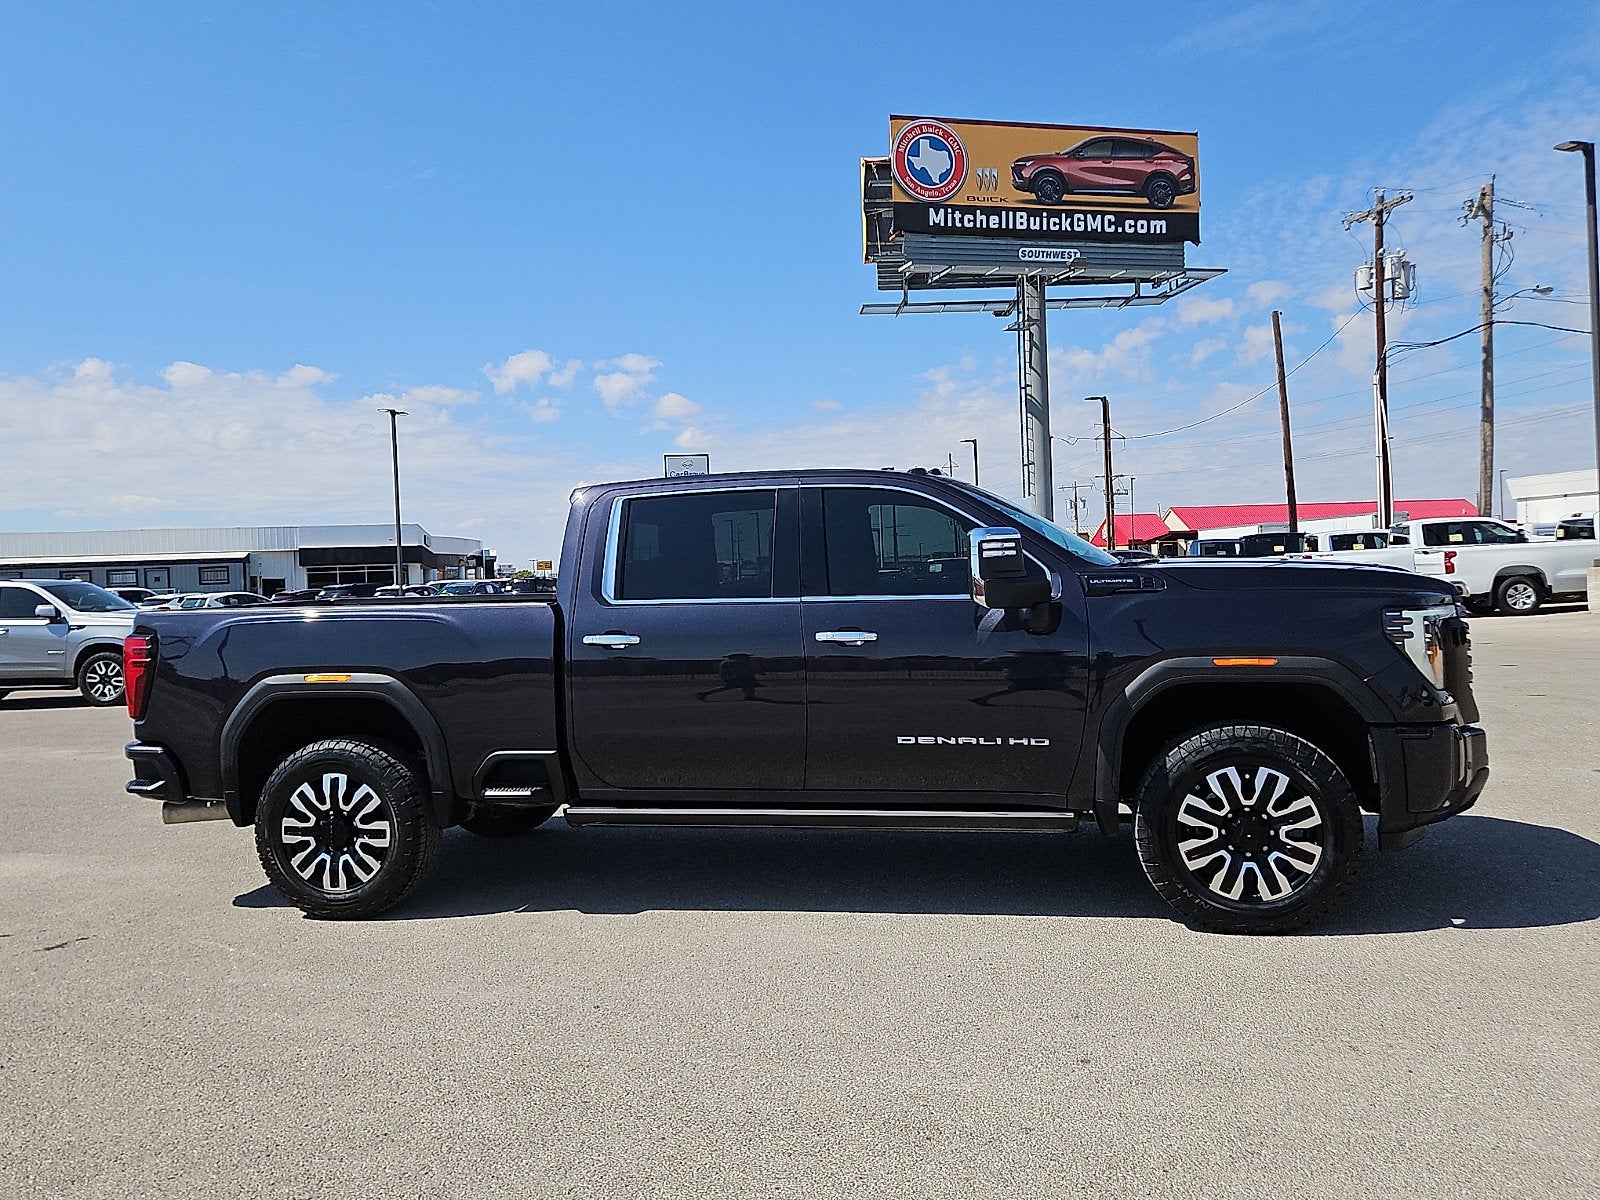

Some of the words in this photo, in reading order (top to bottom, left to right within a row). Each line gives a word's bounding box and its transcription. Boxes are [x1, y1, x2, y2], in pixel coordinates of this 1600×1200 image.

[898, 127, 922, 153] Mitchell
[922, 125, 944, 137] Buick
[947, 136, 962, 156] GMC
[903, 176, 915, 189] San
[940, 179, 957, 194] Texas
[966, 195, 1009, 203] BUICK
[928, 207, 1167, 235] MitchellBuickGMC.com
[1020, 249, 1079, 260] SOUTHWEST
[897, 736, 1002, 745] DENALI
[1008, 737, 1050, 746] HD
